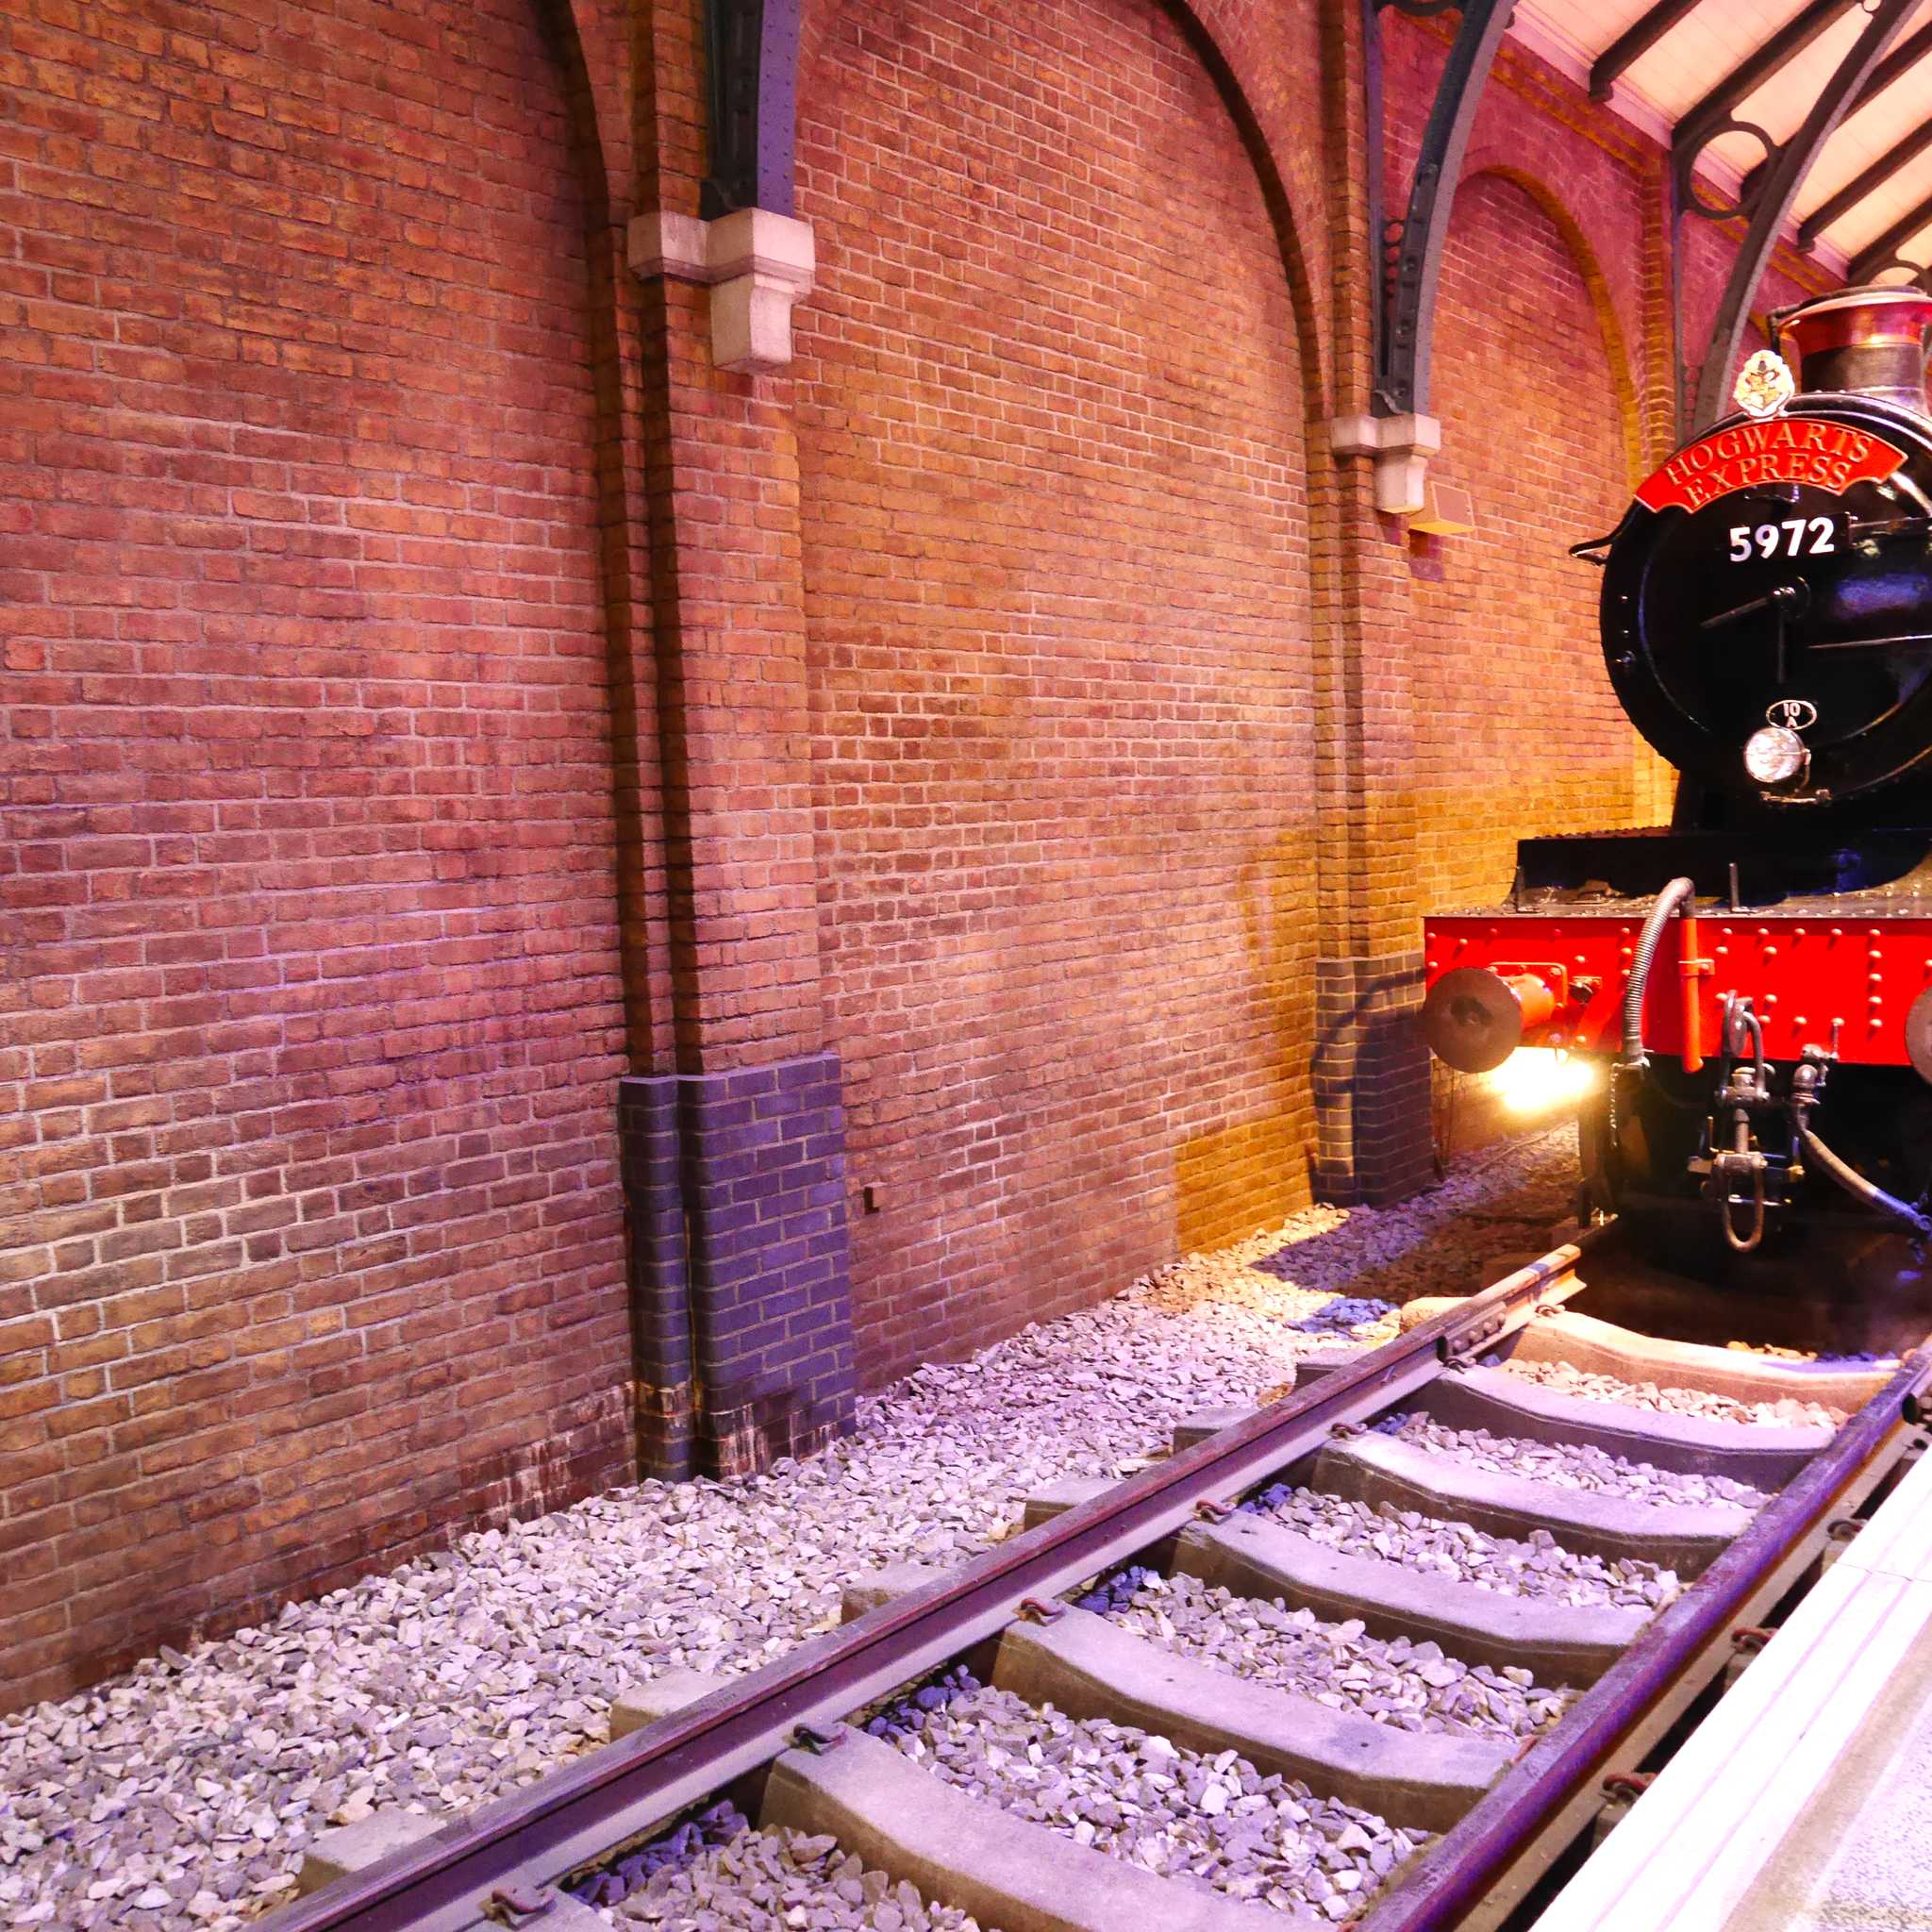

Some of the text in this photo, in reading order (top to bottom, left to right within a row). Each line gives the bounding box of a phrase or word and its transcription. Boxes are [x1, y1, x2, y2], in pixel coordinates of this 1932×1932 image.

[1666, 422, 1874, 486] HOGWARTS
[1684, 453, 1853, 508] EXPRESS
[1729, 517, 1835, 562] 5972
[1782, 702, 1801, 717] 10
[1786, 716, 1797, 727] A
